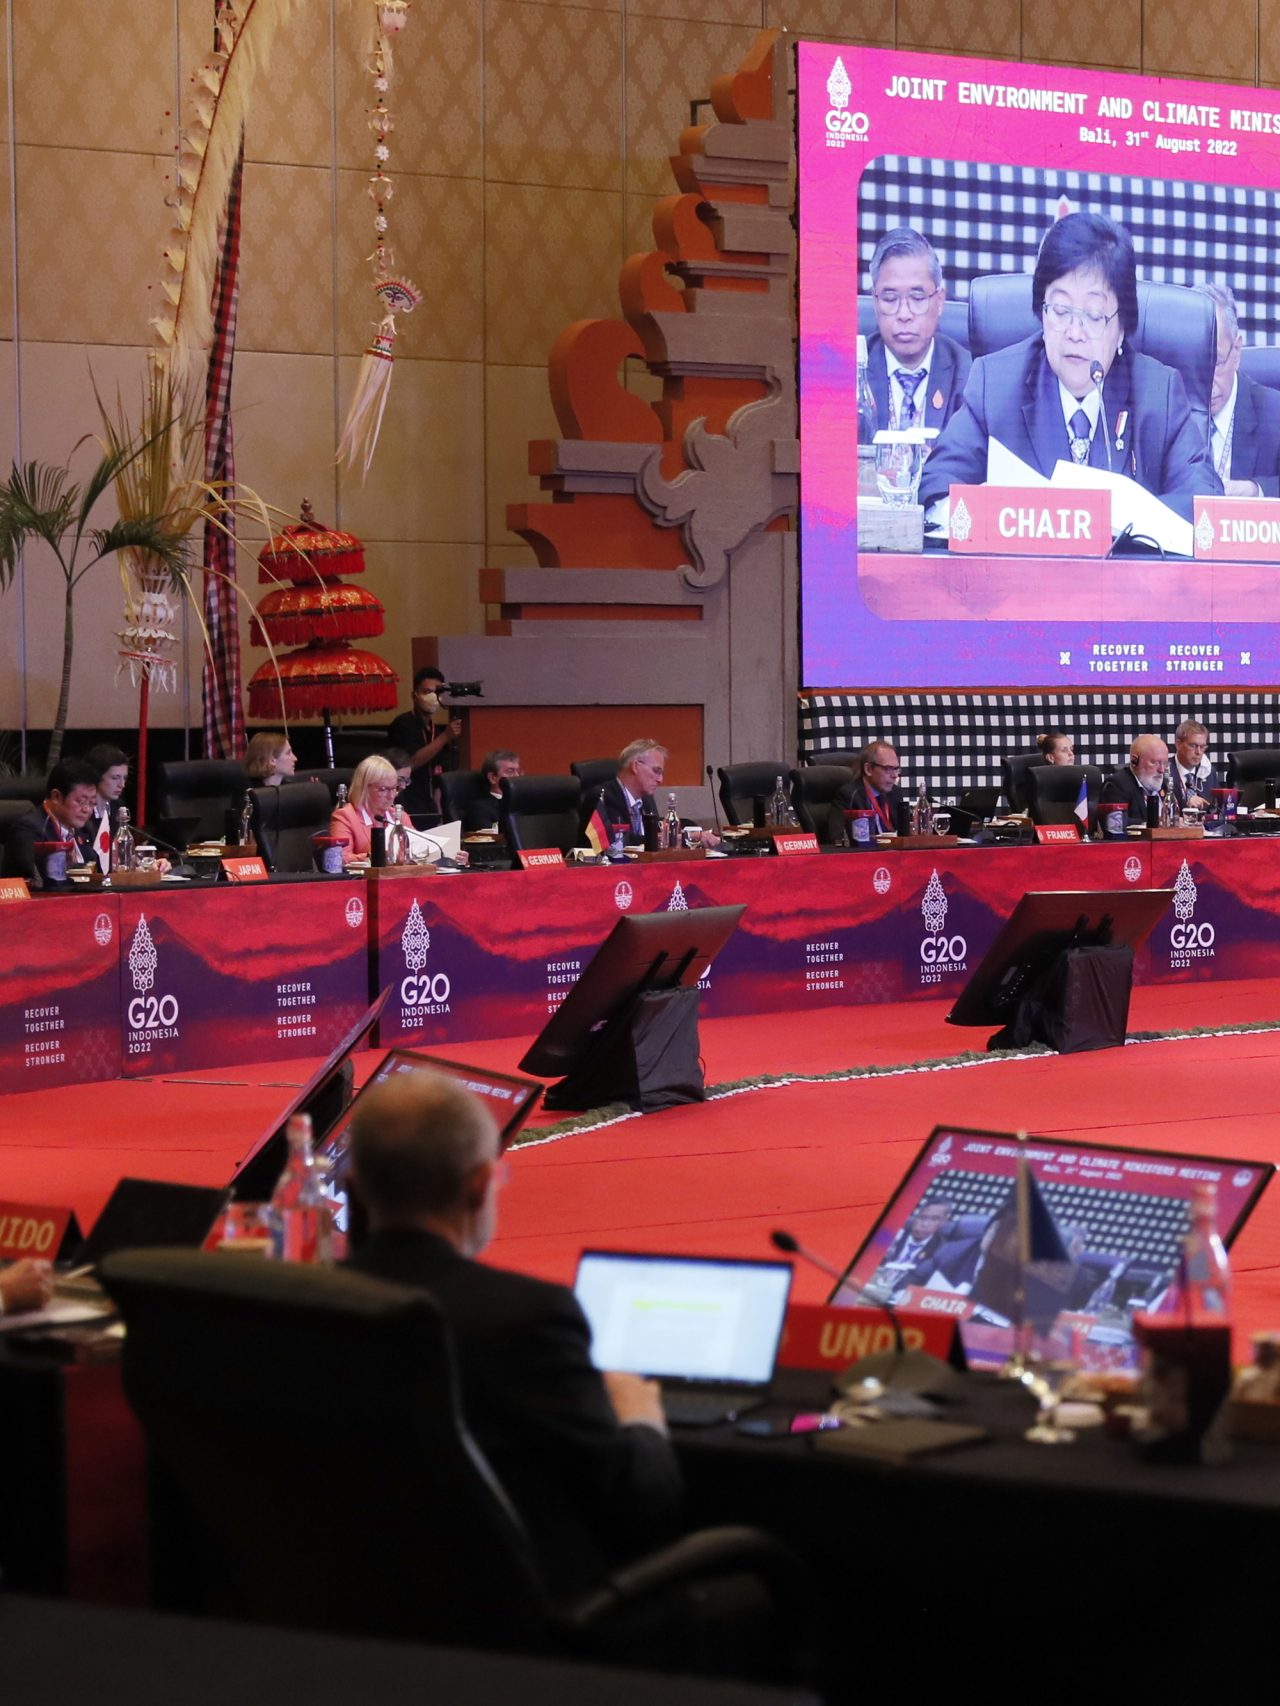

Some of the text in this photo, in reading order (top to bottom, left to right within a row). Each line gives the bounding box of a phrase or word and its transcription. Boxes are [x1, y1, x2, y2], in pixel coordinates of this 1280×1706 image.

[885, 76, 947, 101] JOINT
[958, 82, 1088, 115] ENVIRONMENT
[1098, 96, 1132, 119] AND
[1143, 100, 1220, 128] CLIMATE
[825, 110, 869, 133] G20
[826, 132, 869, 142] INDONESIA
[1079, 127, 1238, 156] Bali, 31st August 2022
[999, 507, 1091, 540] CHAIR
[1093, 644, 1145, 657] RECOVER
[1169, 645, 1221, 657] RECOVER
[1089, 660, 1149, 672] TOGETHER
[1166, 660, 1224, 672] STRONGER
[1046, 830, 1076, 840] FRANCE
[783, 838, 818, 851] GERMANY
[528, 853, 563, 867] GERMANY
[238, 863, 261, 876] JAPAN
[1170, 922, 1215, 949] G20
[806, 942, 839, 953] RECOVER
[920, 935, 967, 963] G20
[1170, 948, 1215, 958] INDONESIA
[806, 953, 844, 964] TOGETHER
[1170, 958, 1190, 968] 2022
[547, 961, 581, 972] RECOVER
[920, 962, 967, 974] INDONESIA
[547, 973, 583, 984] TOGETHE
[806, 970, 839, 980] RECOVER
[920, 974, 941, 983] 2022
[277, 982, 312, 994] RECOVER
[401, 973, 450, 1005] G20
[806, 980, 844, 991] STRONGER
[277, 995, 316, 1007] TOGETHER
[25, 1006, 60, 1018] RECOVER
[128, 994, 179, 1029] G20
[401, 1003, 451, 1017] INDONESIA
[277, 1014, 312, 1025] RECOVER
[401, 1017, 424, 1028] 2022
[25, 1020, 64, 1033] TOGETHER
[277, 1026, 317, 1039] STRONGER
[128, 1027, 179, 1042] INDONESIA
[25, 1040, 60, 1053] RECOVER
[128, 1042, 151, 1054] 2022
[25, 1053, 65, 1067] STRONGER
[920, 1295, 968, 1315] CHAIR
